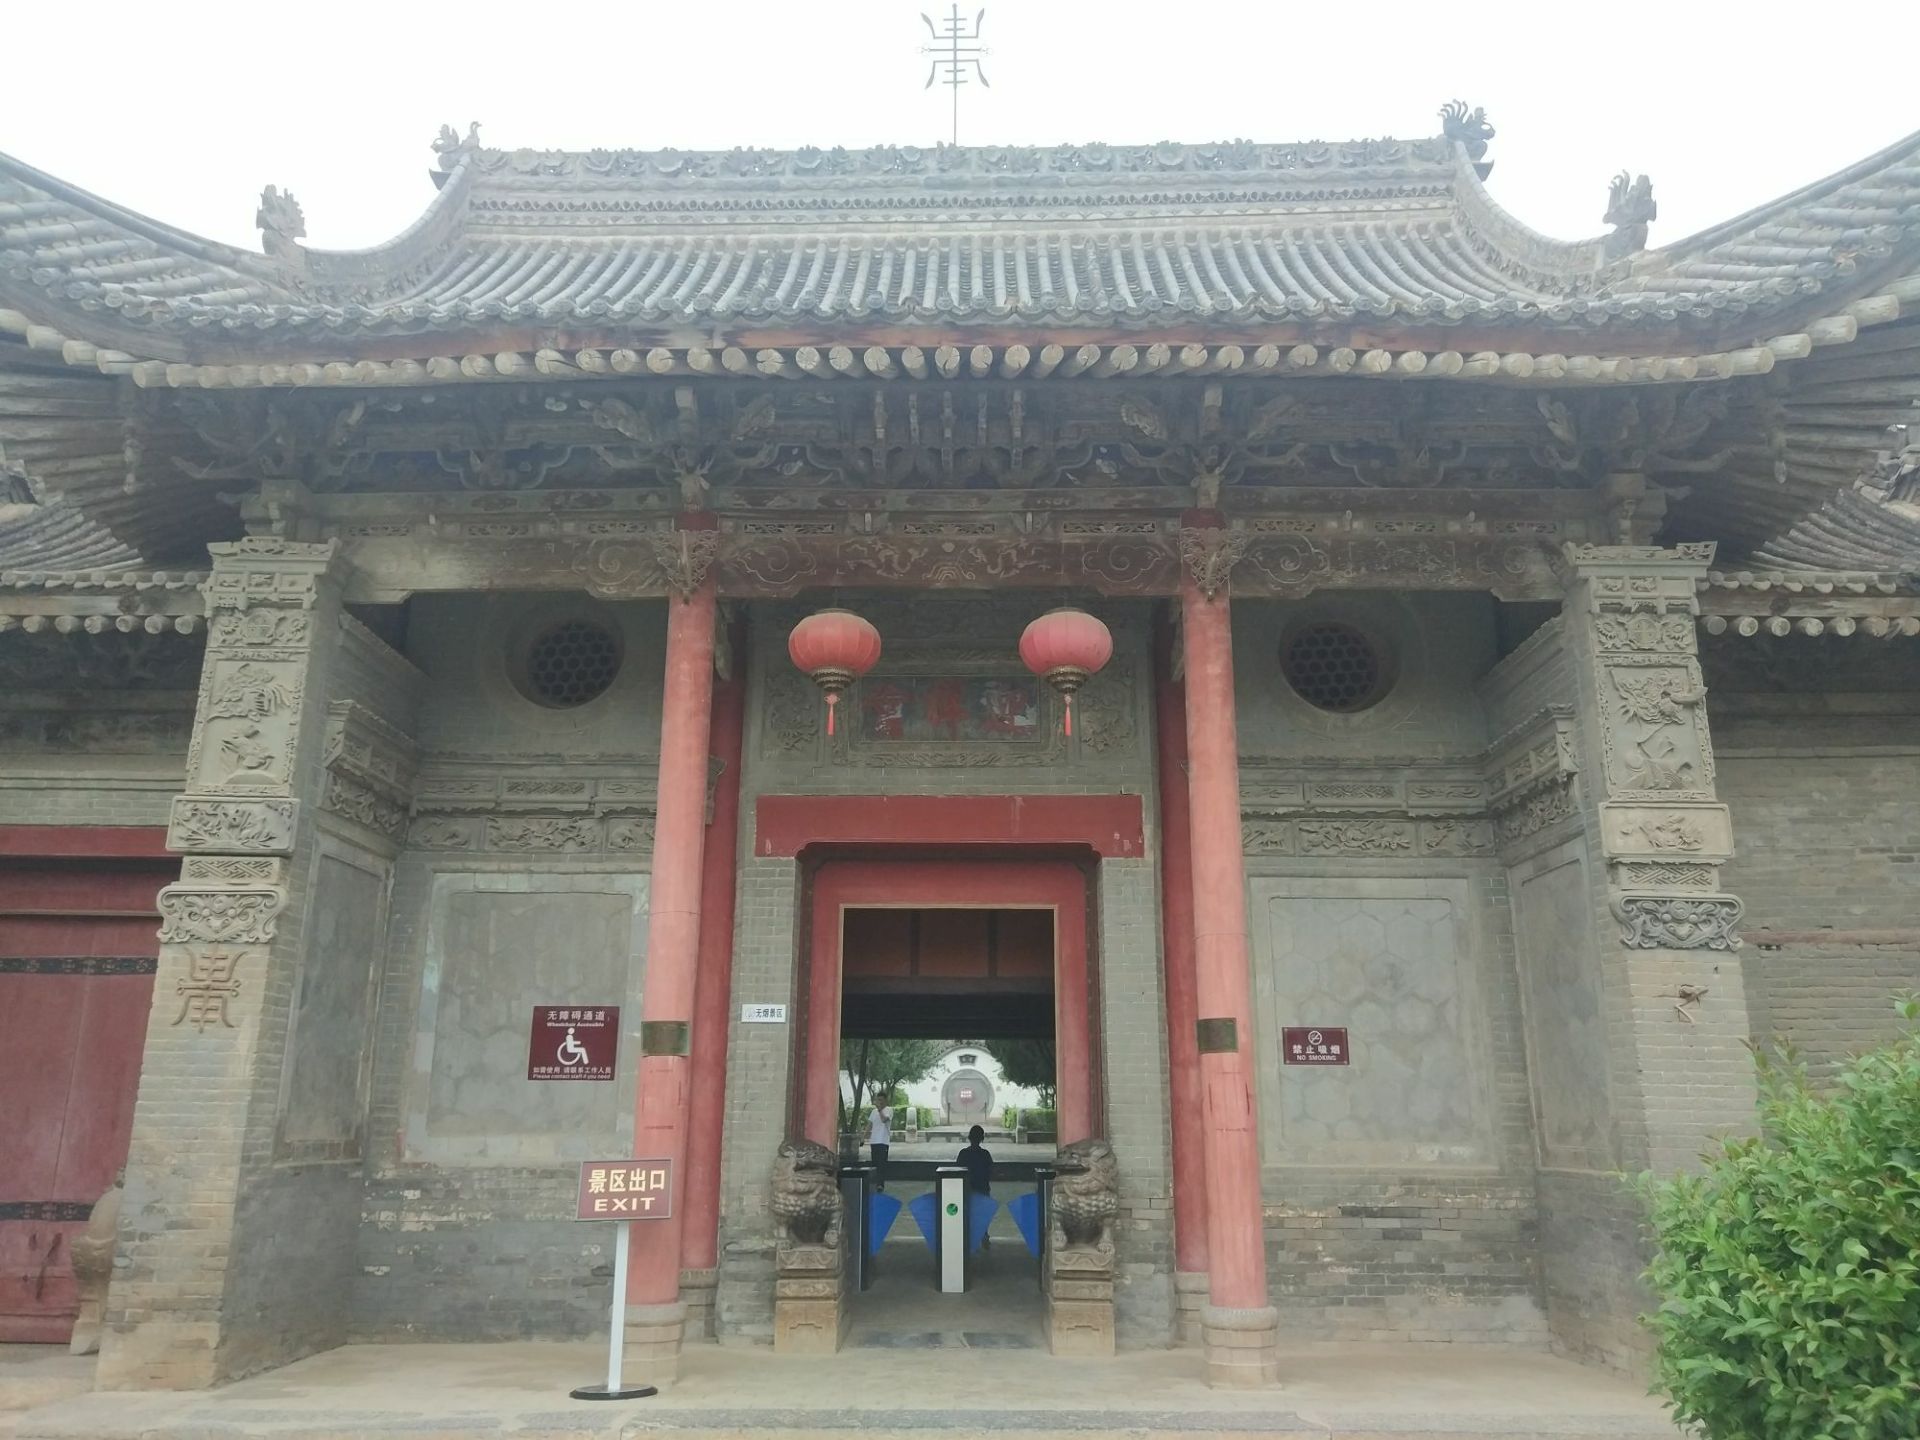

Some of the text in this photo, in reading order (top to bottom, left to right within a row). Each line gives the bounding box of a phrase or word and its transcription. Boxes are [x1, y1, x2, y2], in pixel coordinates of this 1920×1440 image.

[547, 1010, 606, 1021] 无障碍通道
[1292, 1044, 1341, 1055] 禁止吸烟
[532, 1066, 612, 1074] 如需使用 请联系工作人员
[588, 1168, 665, 1194] 景区出口
[594, 1197, 656, 1212] EXIT
